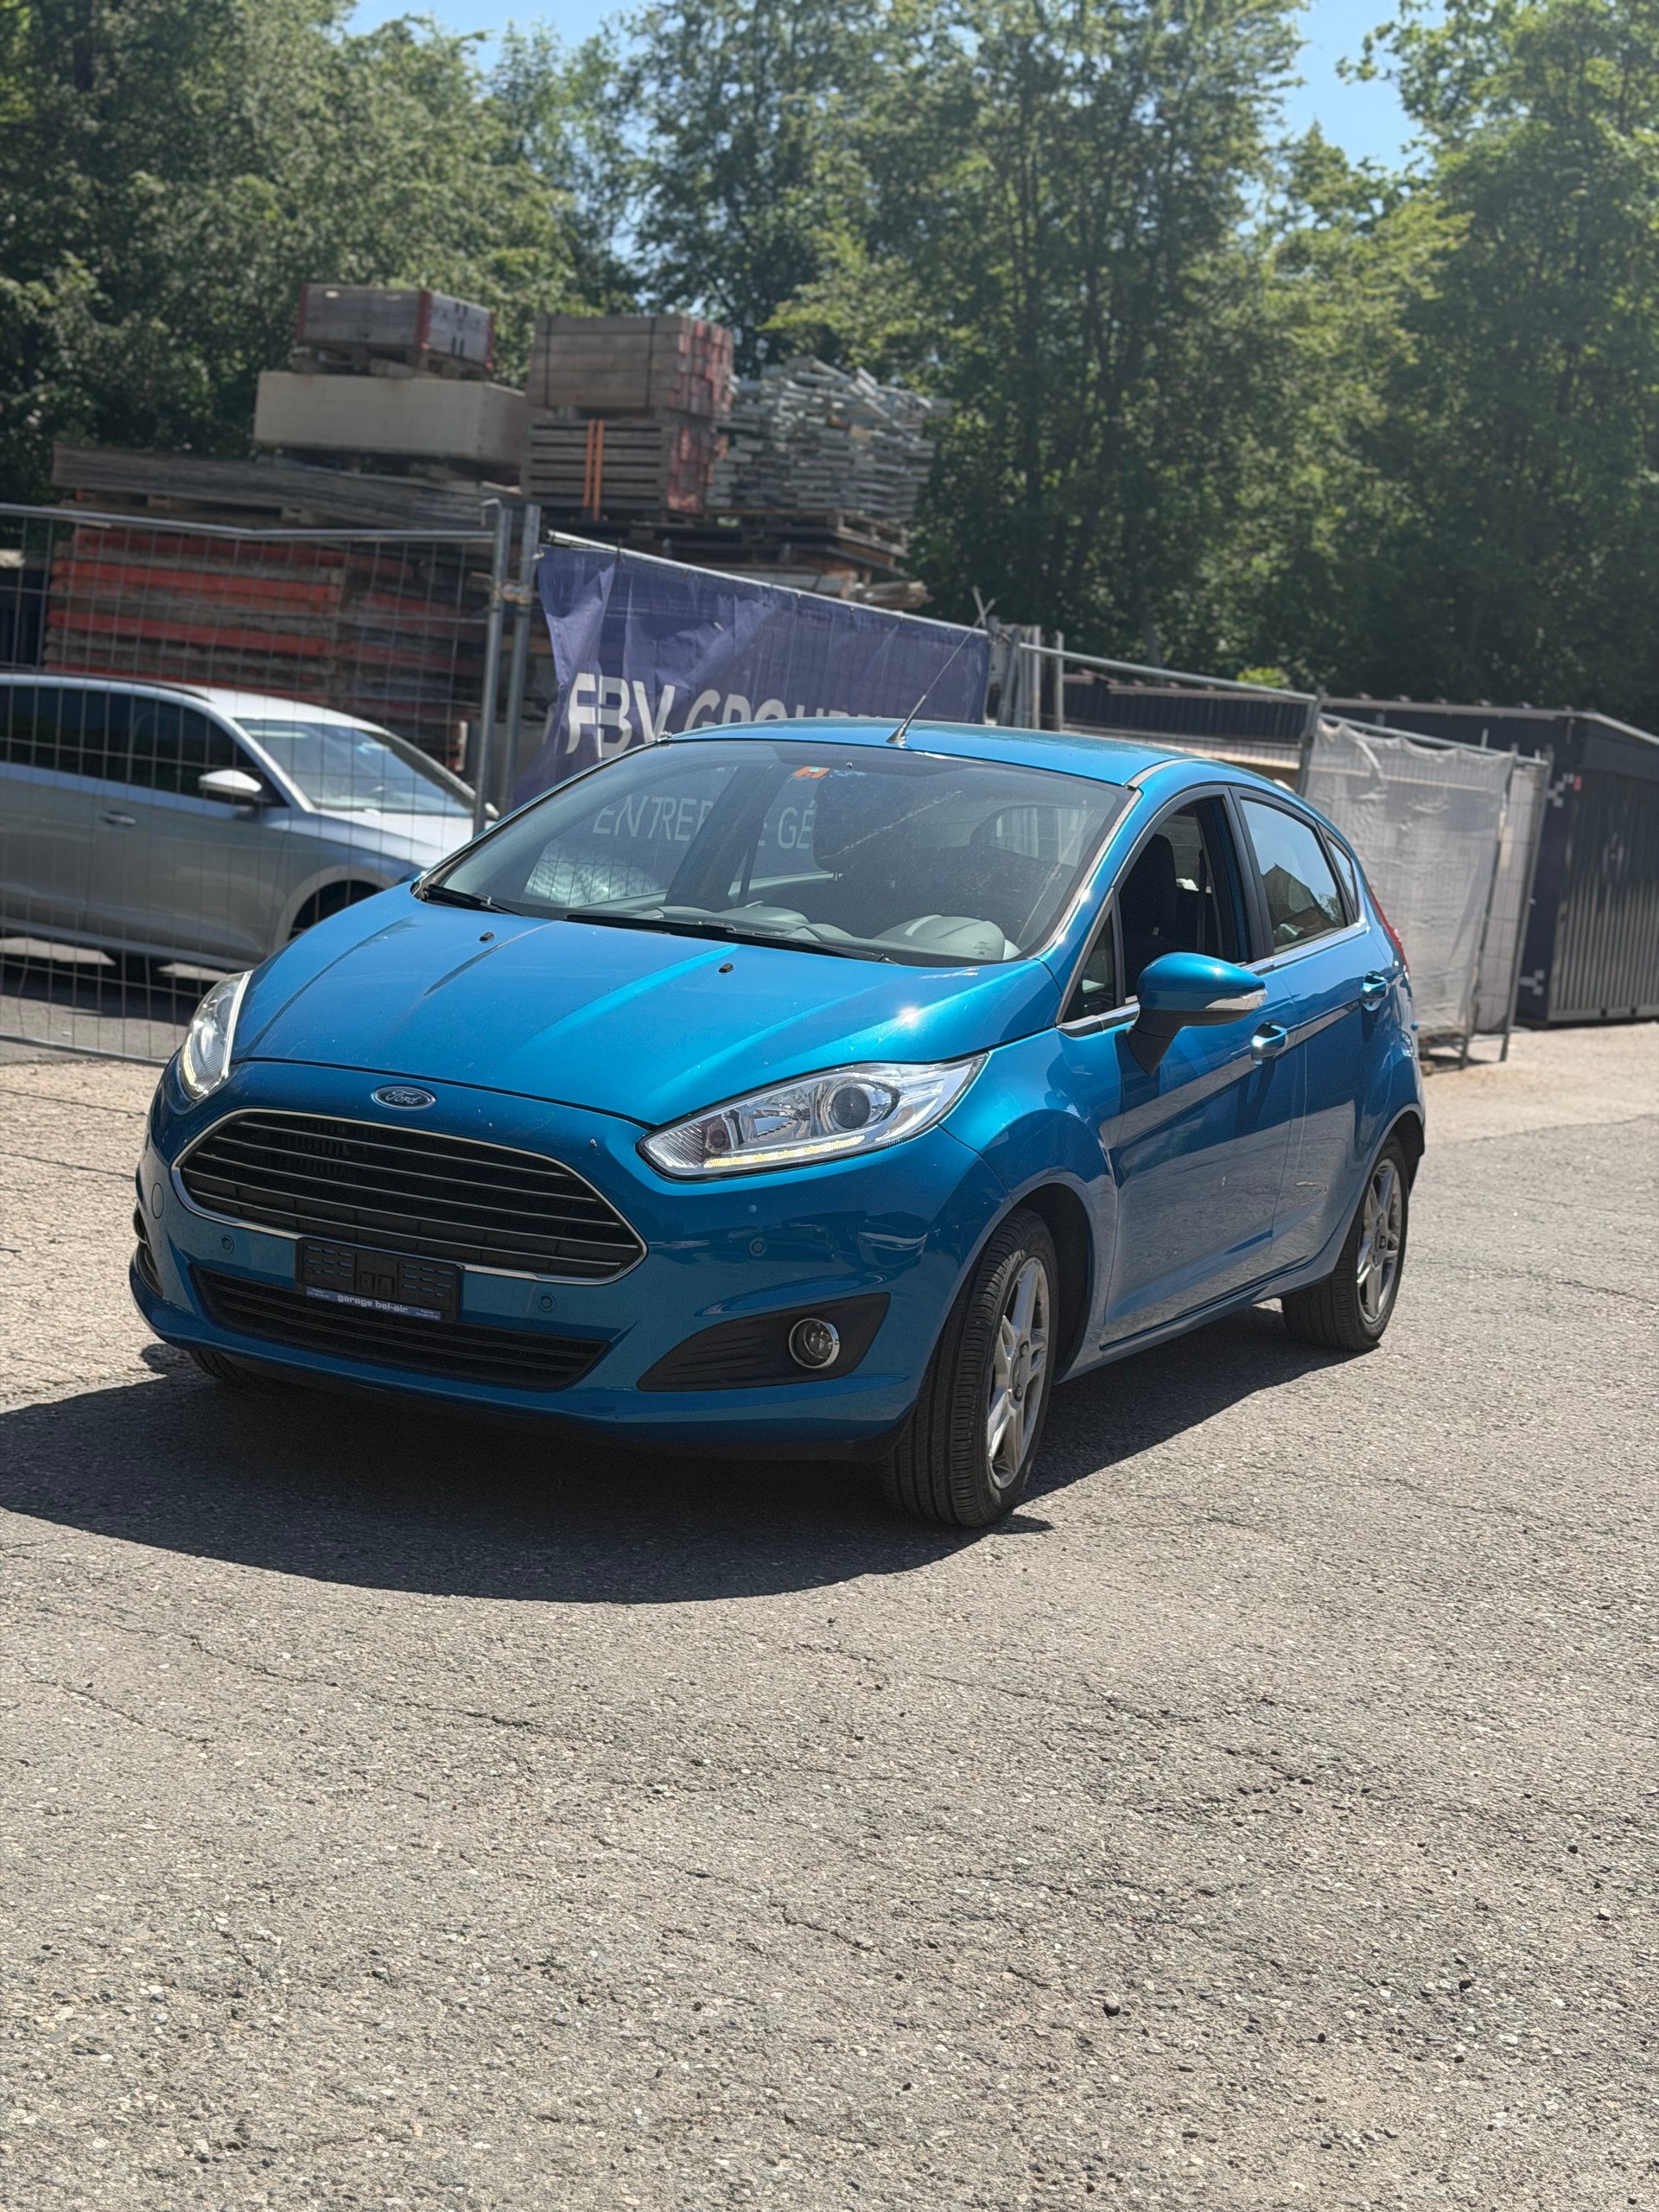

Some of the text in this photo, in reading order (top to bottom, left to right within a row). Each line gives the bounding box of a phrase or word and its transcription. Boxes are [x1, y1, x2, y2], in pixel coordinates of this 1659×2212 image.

[565, 672, 676, 759] FBV
[385, 1090, 422, 1105] Ford
[337, 1294, 373, 1307] garage
